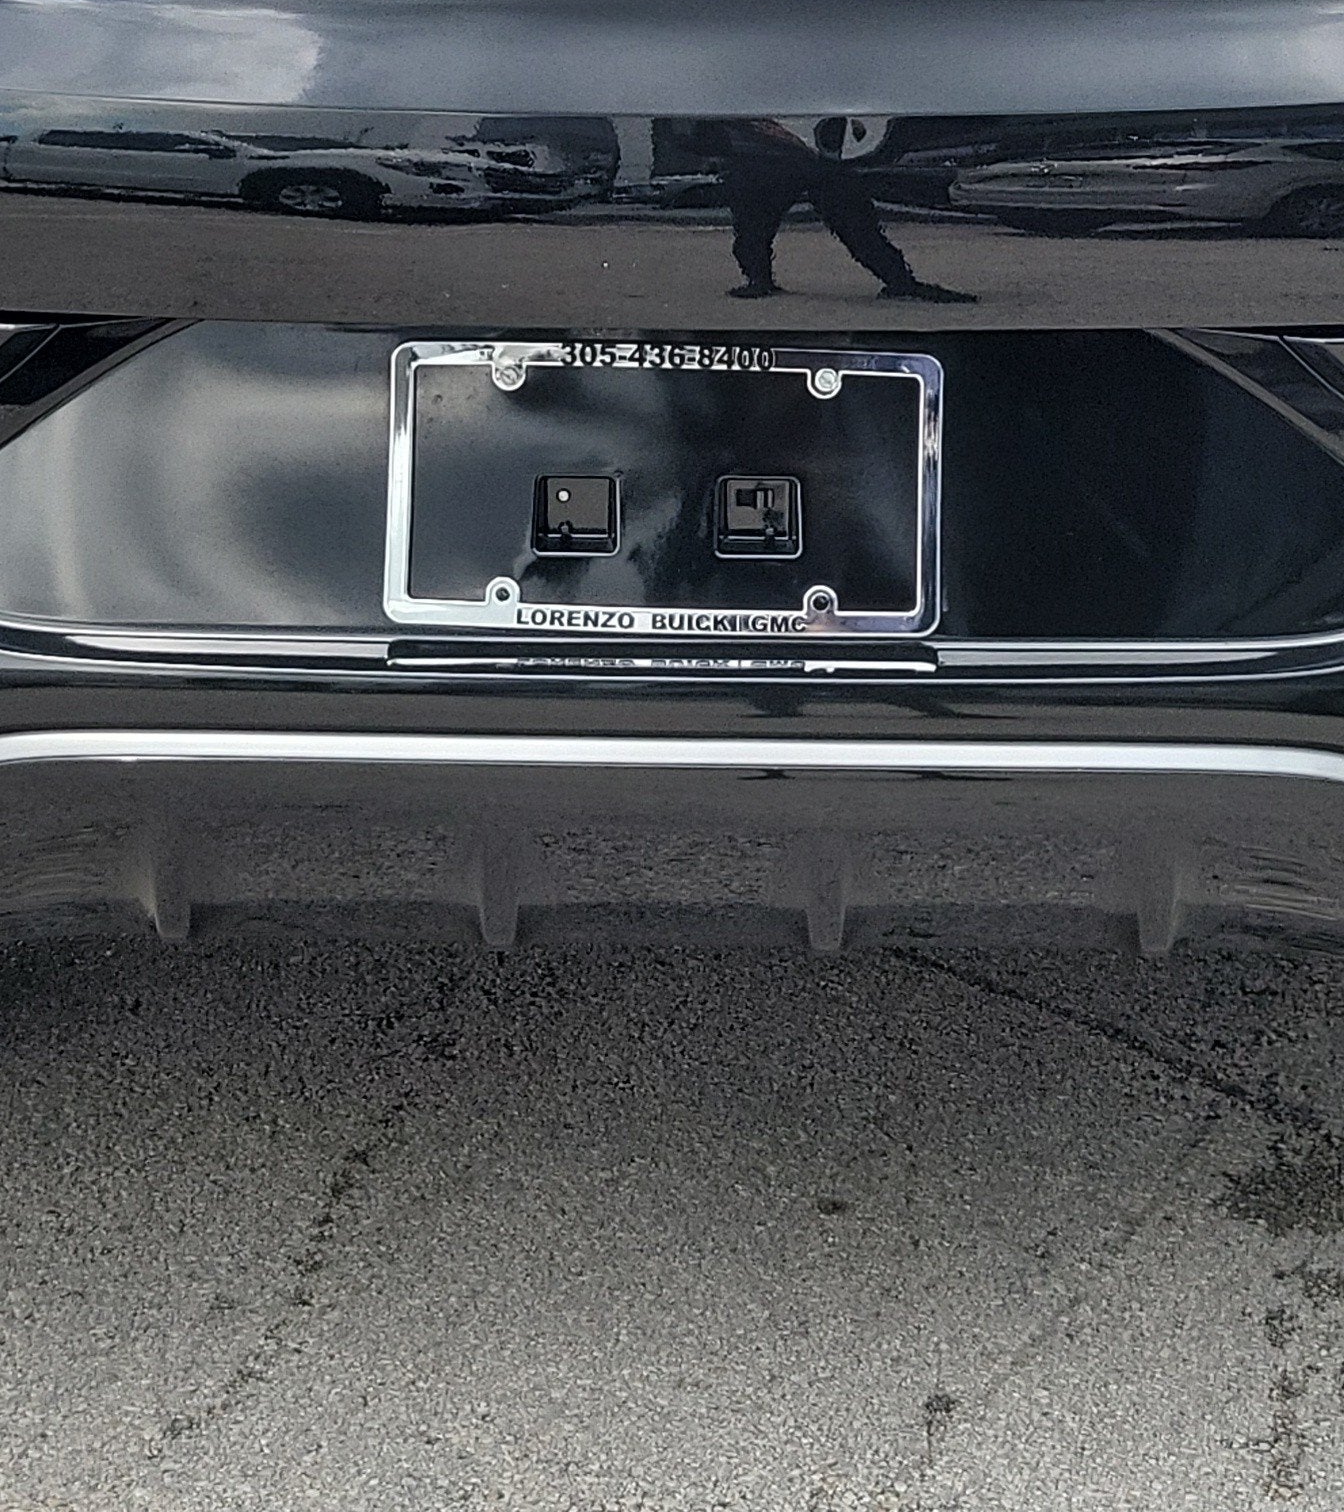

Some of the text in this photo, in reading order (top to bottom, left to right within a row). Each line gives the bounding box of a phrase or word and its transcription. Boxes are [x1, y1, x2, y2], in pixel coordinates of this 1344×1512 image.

[560, 342, 775, 371] 305-436-8400
[516, 608, 807, 633] LORENZO BUICK GMC
